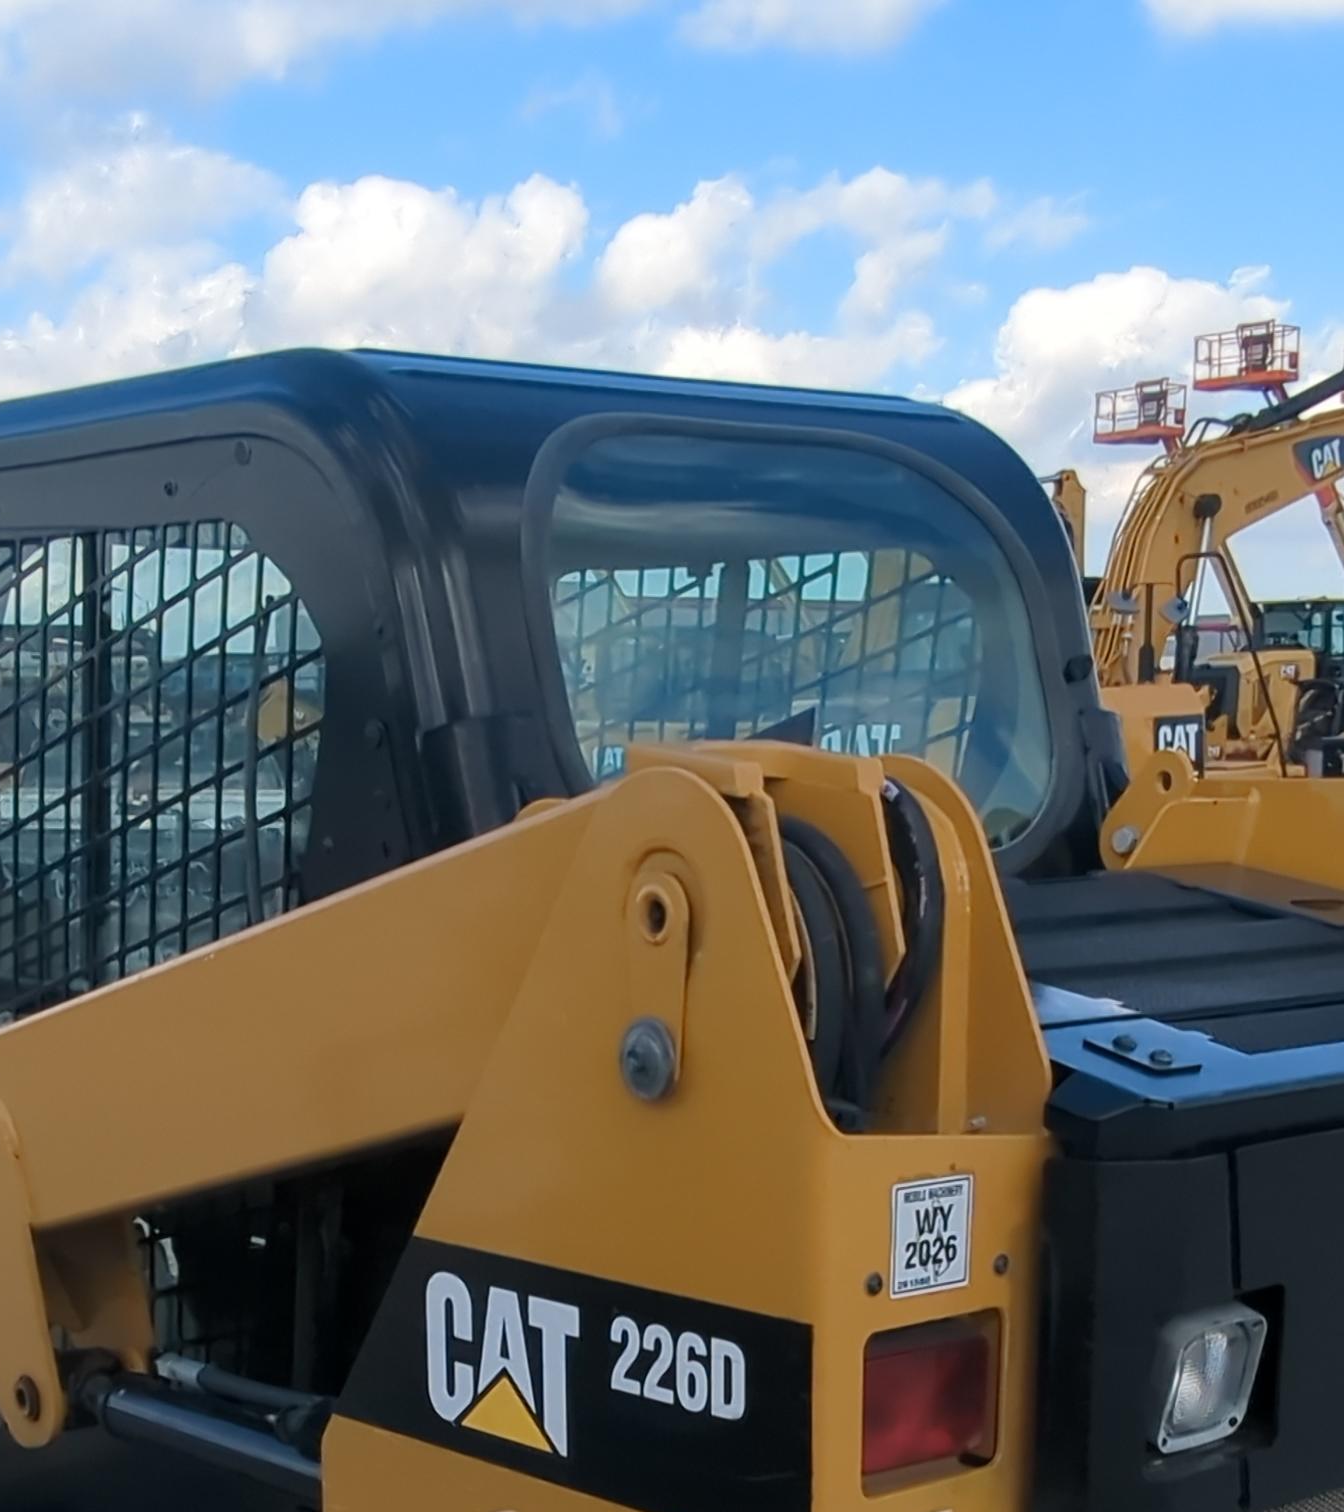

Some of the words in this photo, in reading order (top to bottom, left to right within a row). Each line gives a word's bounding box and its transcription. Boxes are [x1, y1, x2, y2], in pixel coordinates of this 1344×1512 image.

[1311, 438, 1341, 480] CAT
[1158, 723, 1198, 762] CAT
[915, 1203, 955, 1236] WY
[904, 1235, 958, 1270] 2026
[425, 1271, 581, 1459] CAT
[609, 1315, 746, 1421] 226D
